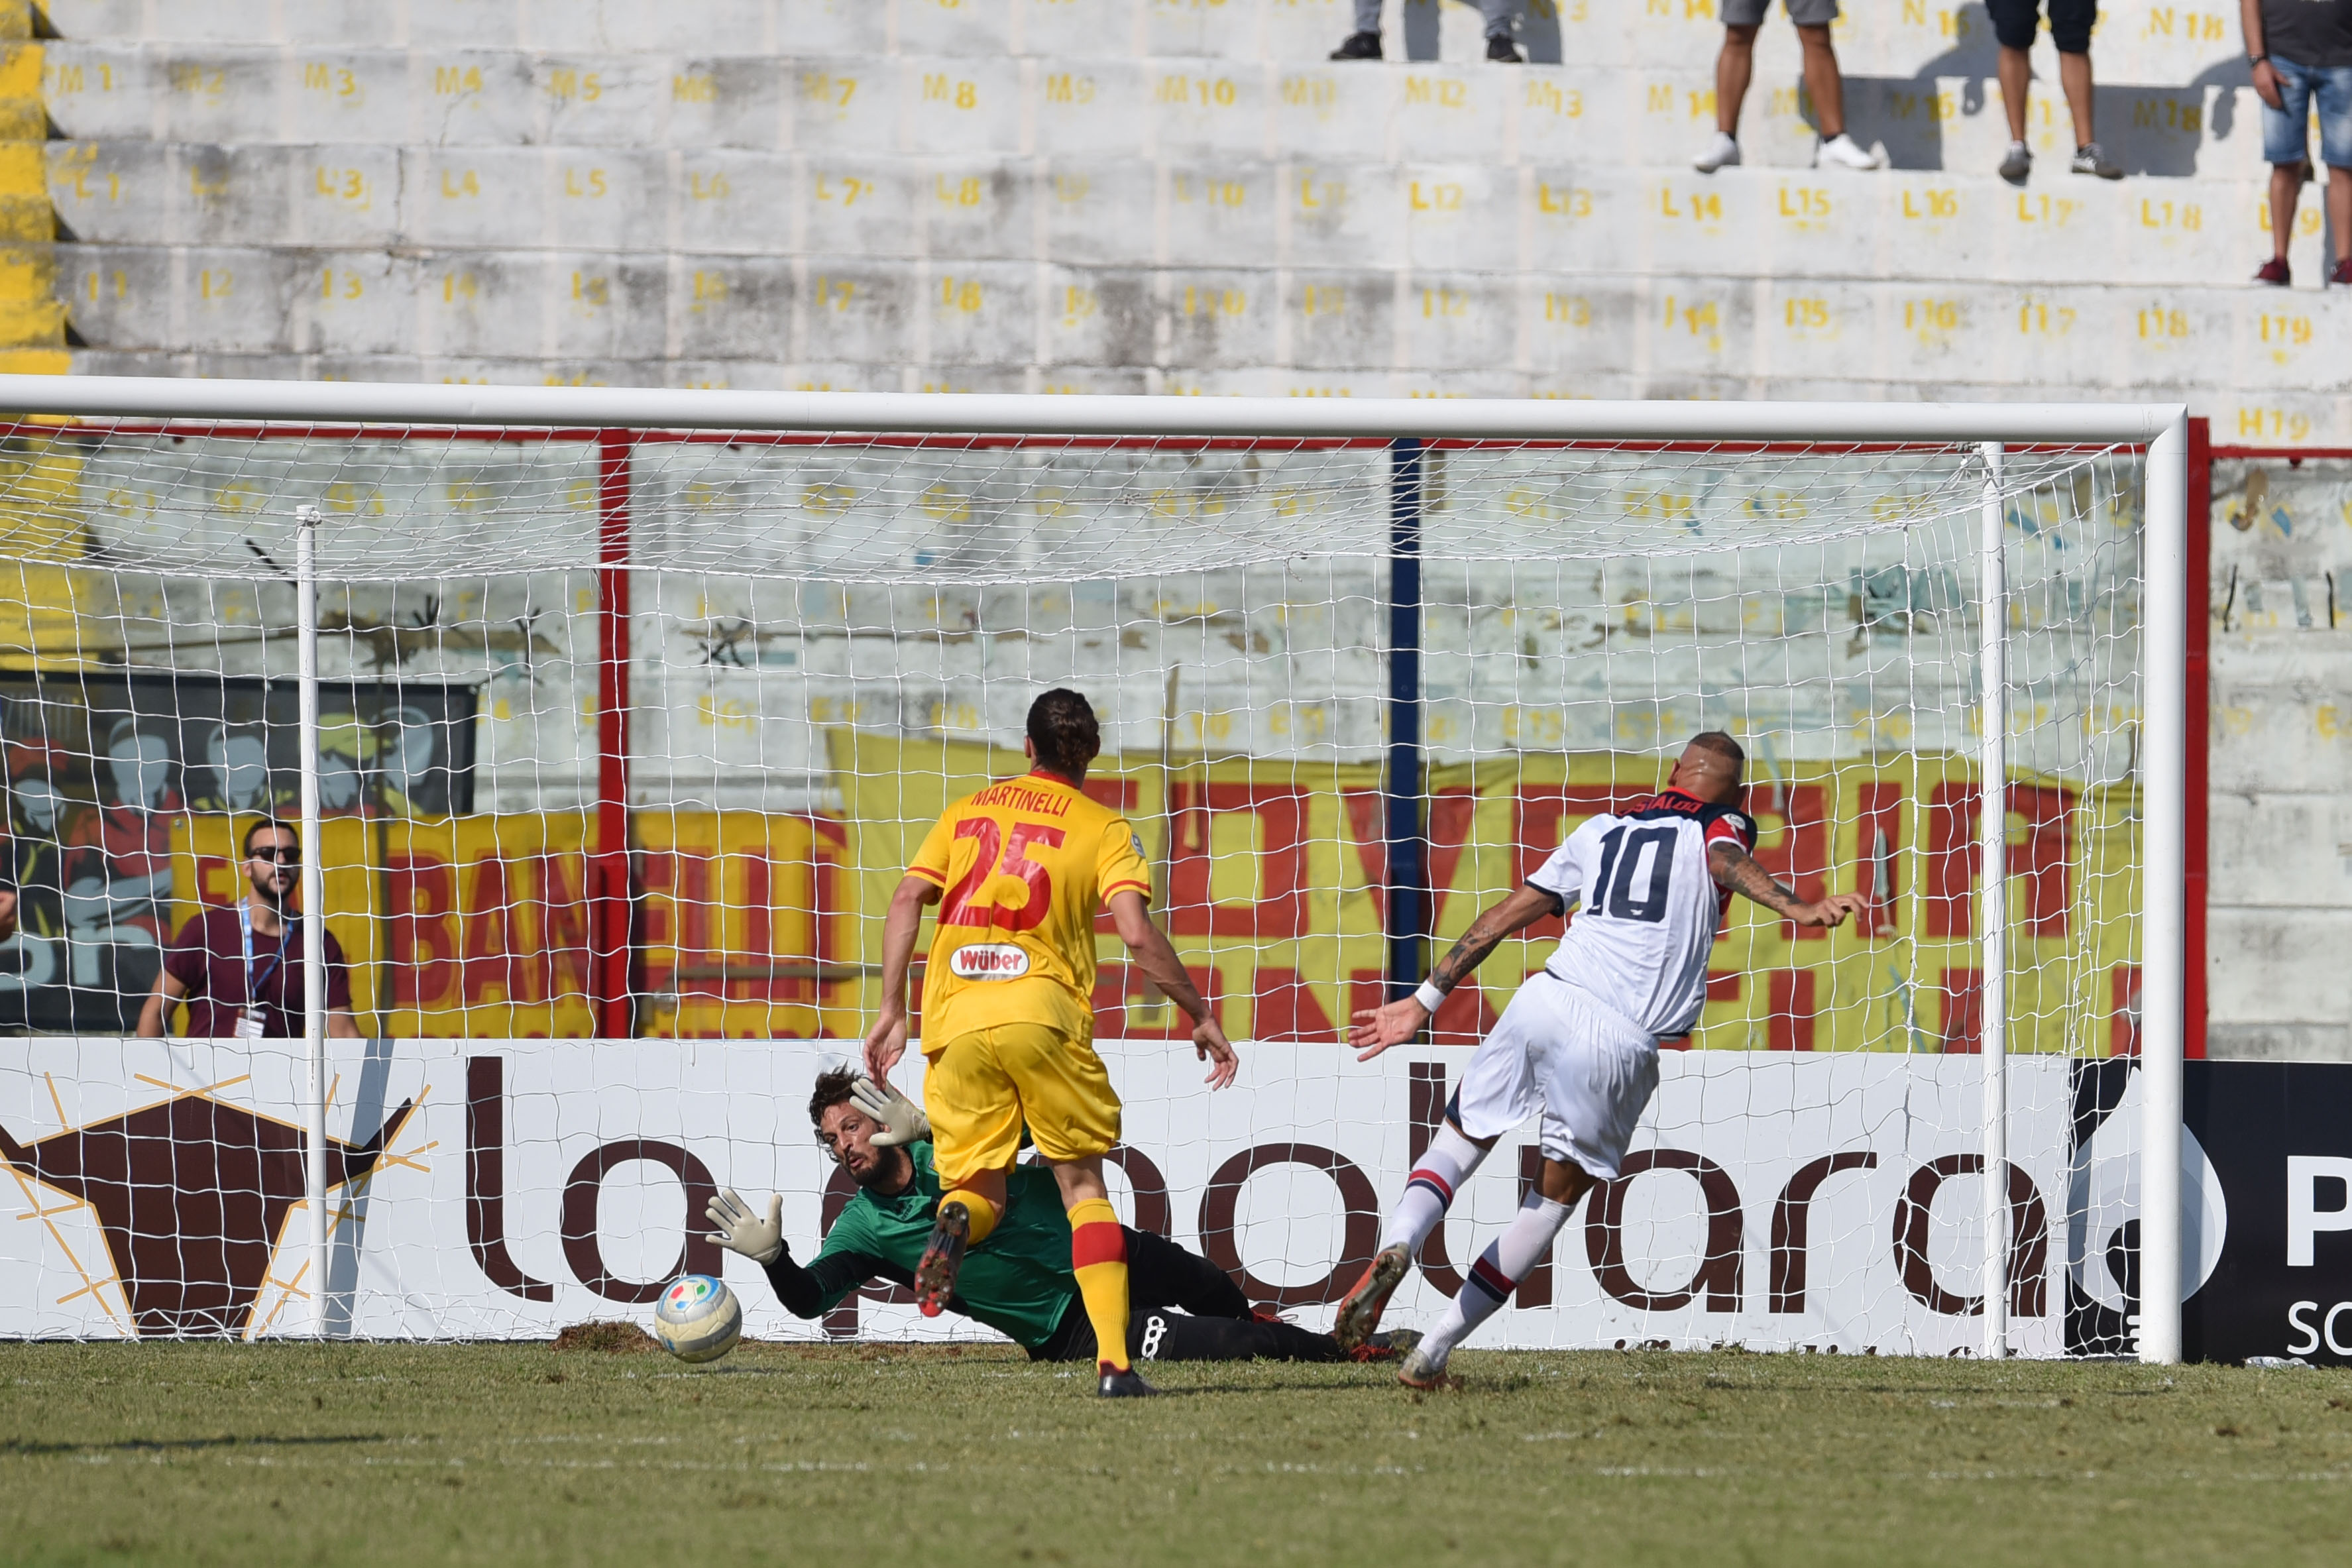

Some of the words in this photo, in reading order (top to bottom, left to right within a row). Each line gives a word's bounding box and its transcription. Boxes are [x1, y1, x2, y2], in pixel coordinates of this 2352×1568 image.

[970, 786, 1073, 818] MARTINELLI
[937, 816, 1067, 932] 25
[1586, 825, 1679, 923] 10
[960, 950, 1022, 970] Wüber
